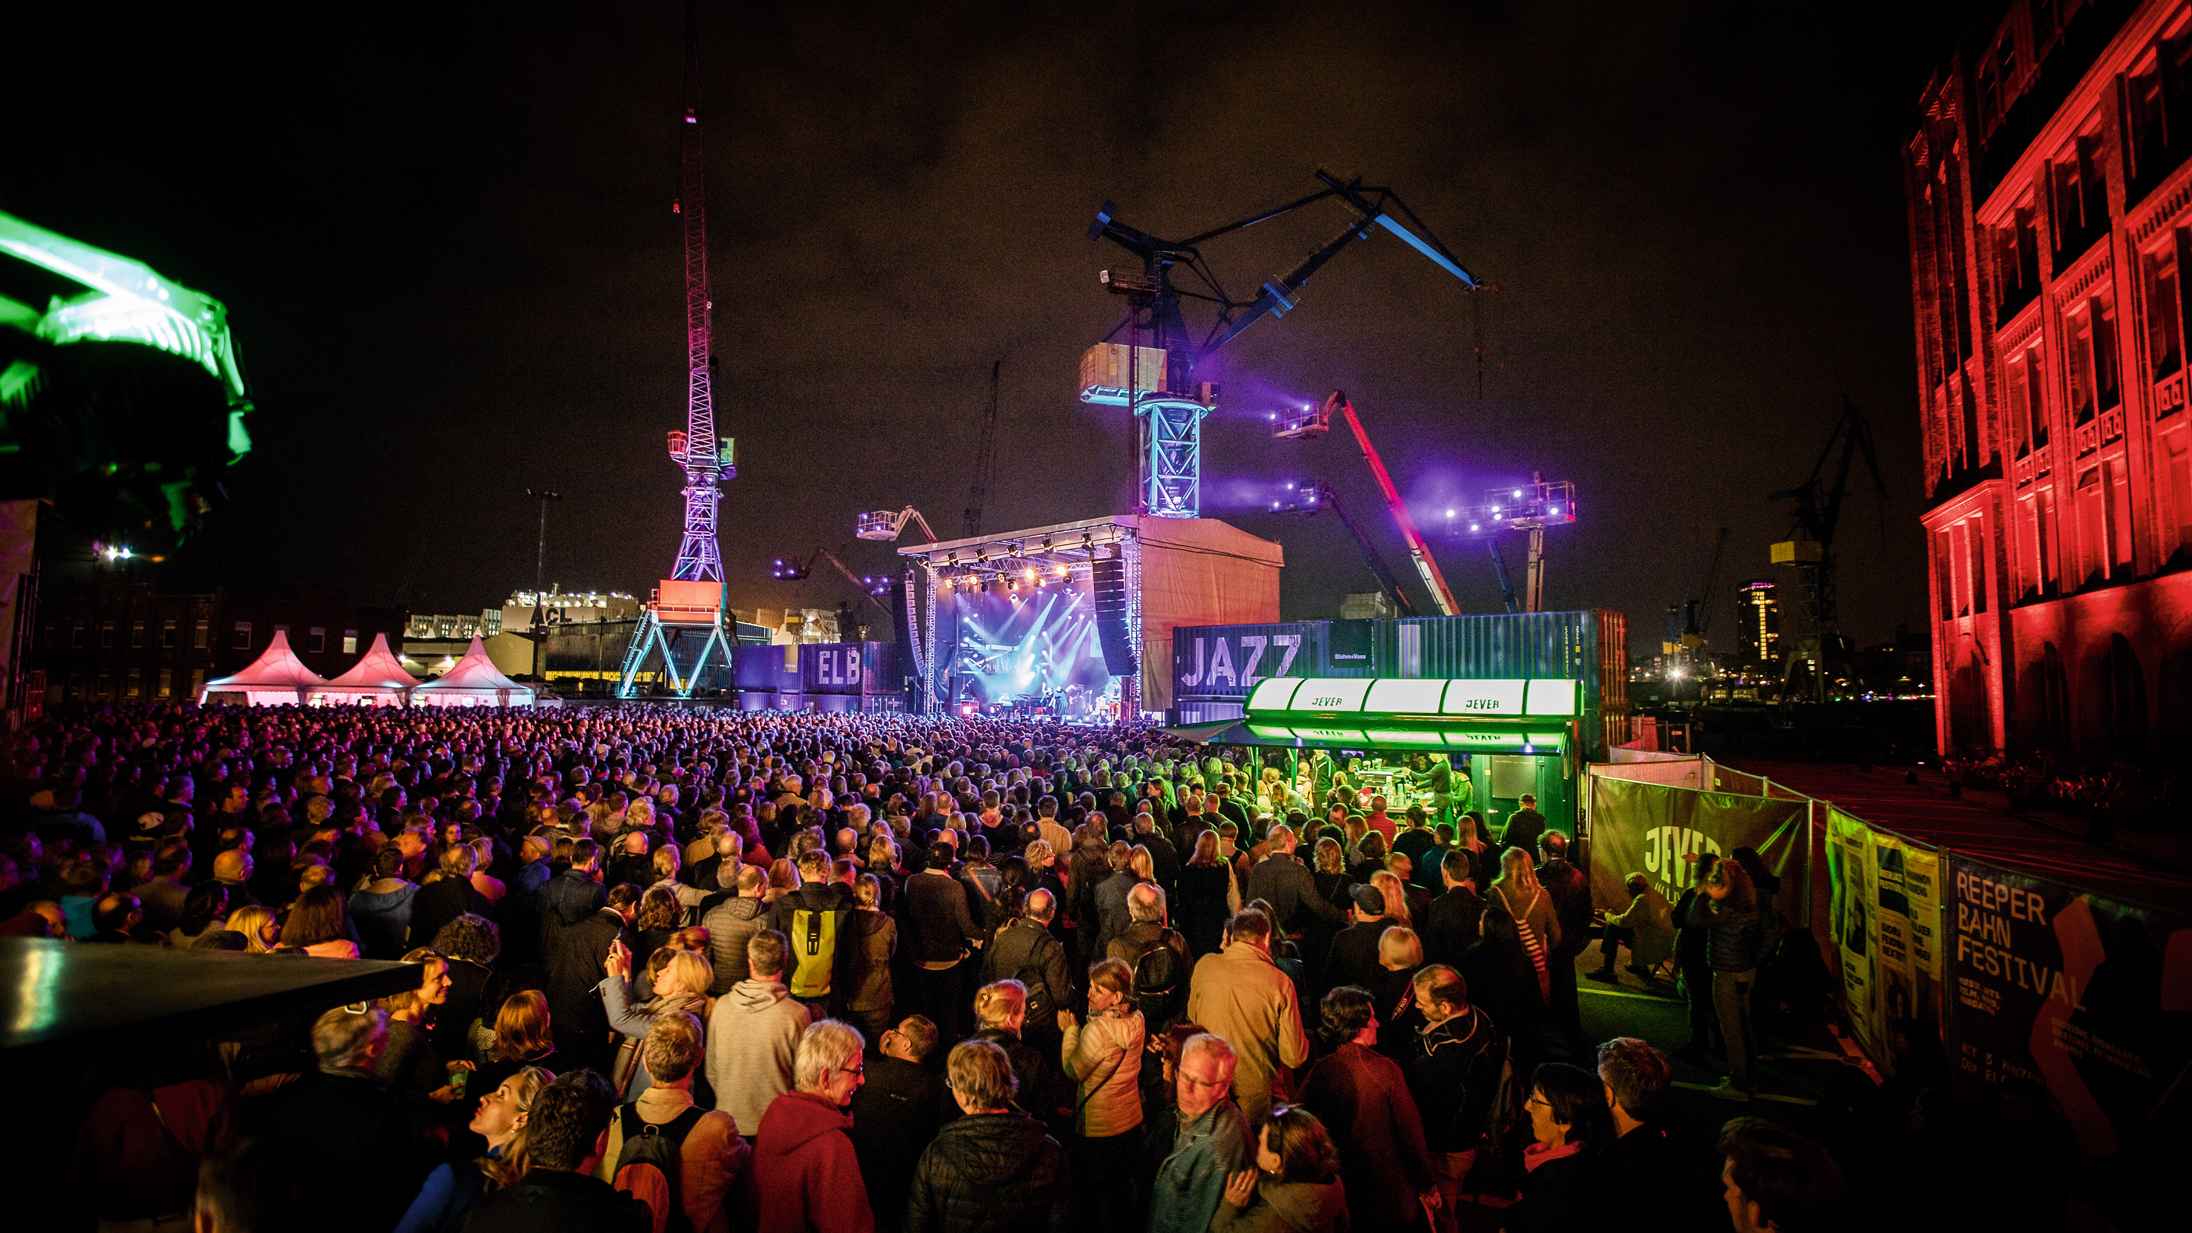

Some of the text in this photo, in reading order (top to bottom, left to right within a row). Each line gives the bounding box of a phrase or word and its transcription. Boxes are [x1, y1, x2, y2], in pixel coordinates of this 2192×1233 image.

[819, 649, 860, 685] ELB
[1181, 634, 1301, 687] JAZZ
[1312, 697, 1343, 707] JEVER
[1465, 699, 1500, 710] JEVER
[1955, 870, 2048, 927] REEPER
[1957, 902, 2013, 949] BAHN
[1957, 935, 2088, 1013] FESTIVAL
